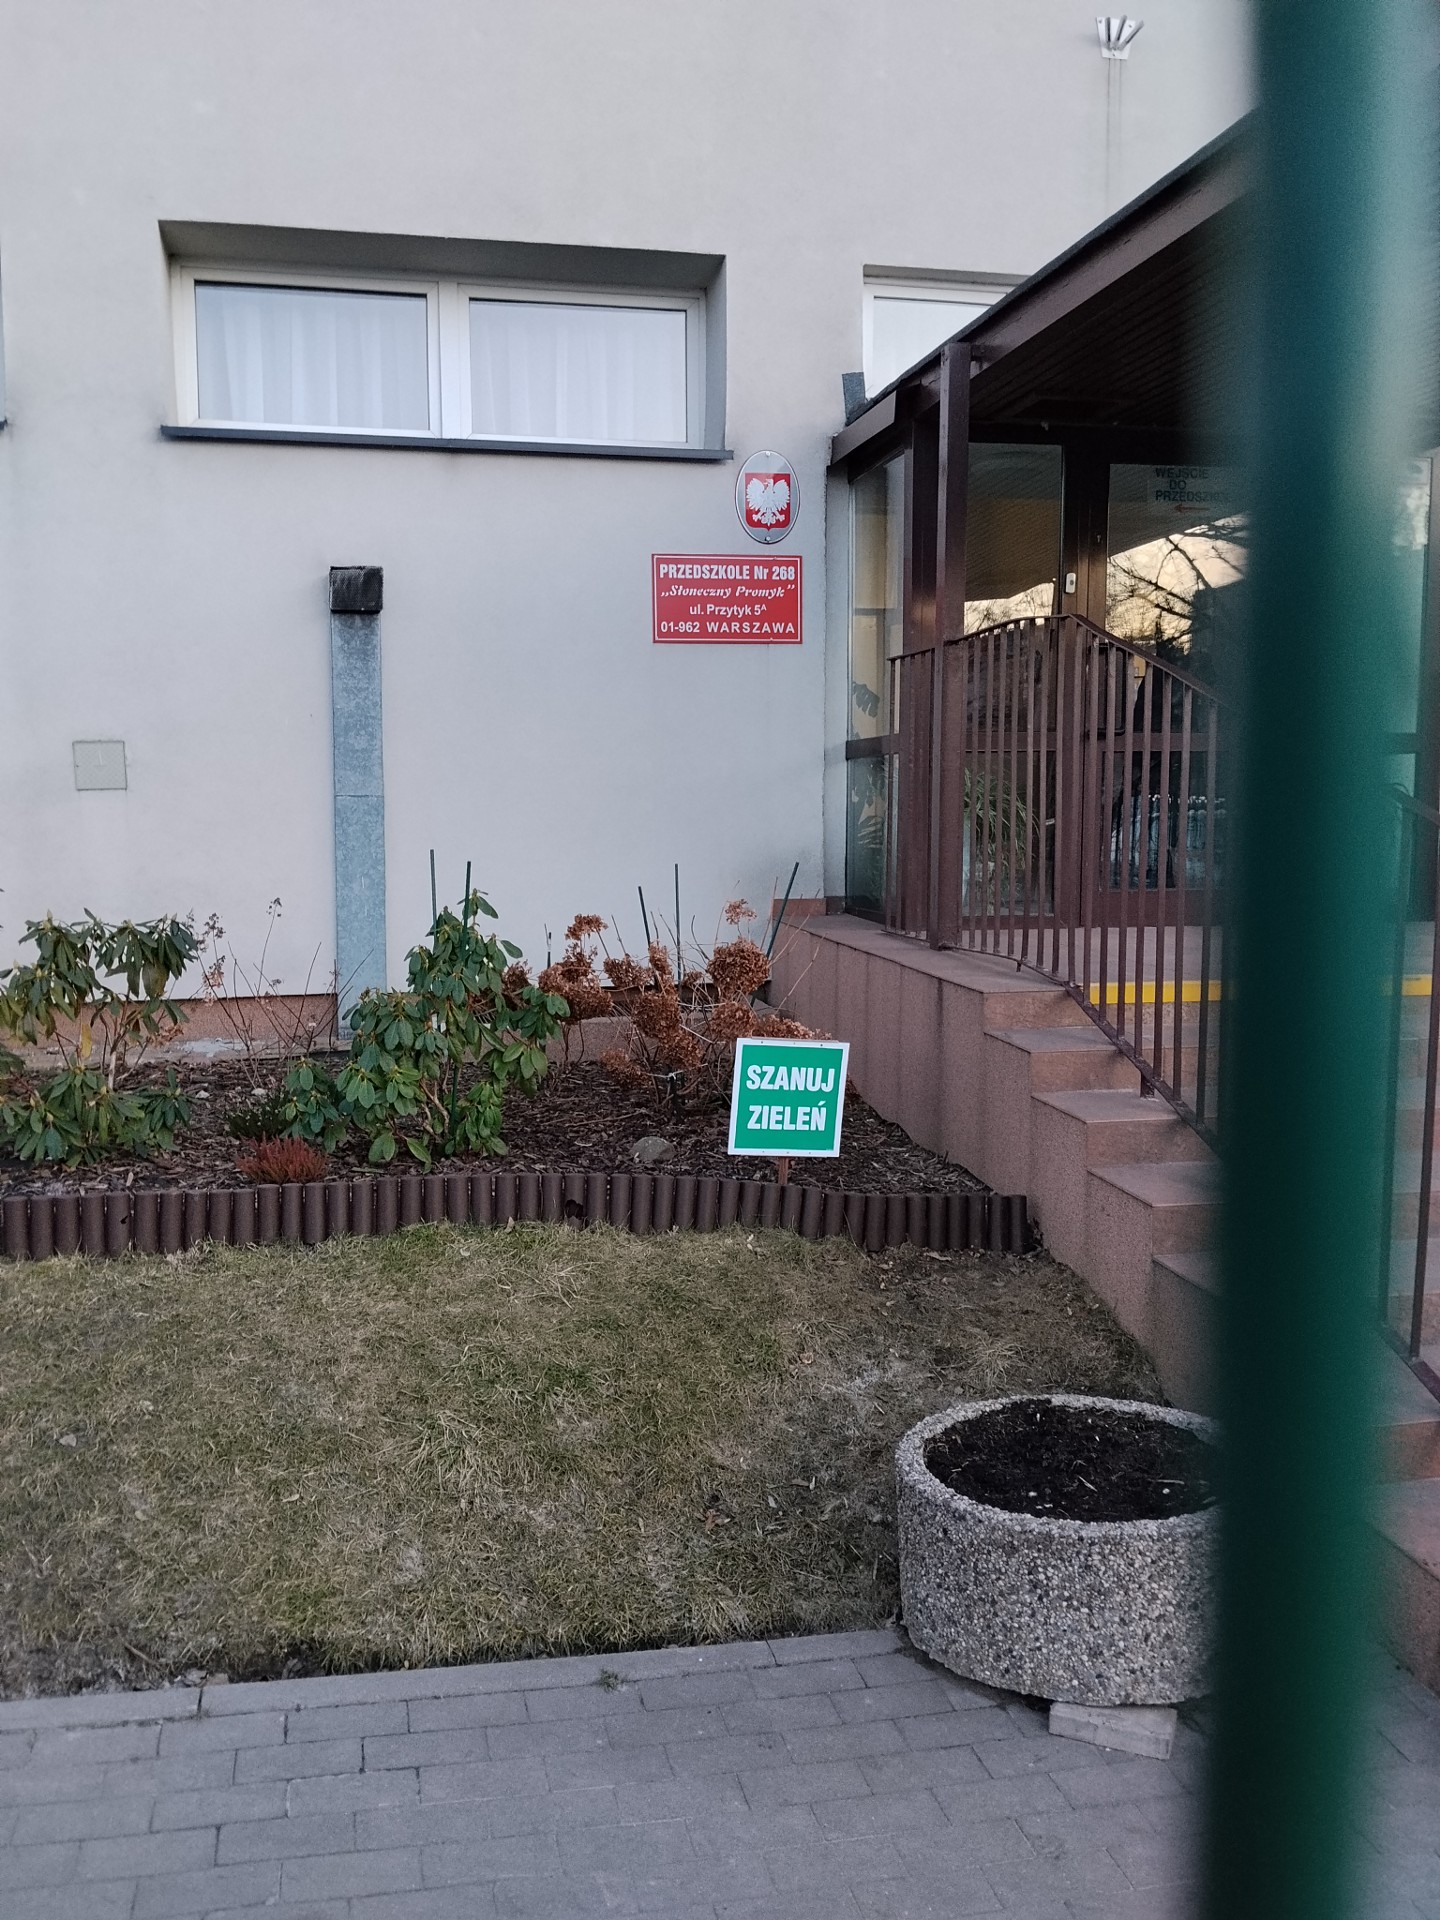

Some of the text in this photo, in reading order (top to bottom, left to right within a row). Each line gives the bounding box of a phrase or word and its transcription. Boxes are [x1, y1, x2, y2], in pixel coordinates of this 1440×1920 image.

[1169, 479, 1187, 490] DO
[659, 563, 796, 581] PRZEDSZKOLE Nr 268
[689, 603, 705, 615] ul.
[706, 603, 752, 618] Przytyk
[660, 621, 796, 634] 01-962 WARSZAWA
[746, 1064, 836, 1093] SZANUJ
[747, 1100, 827, 1132] ZIELEŃ
